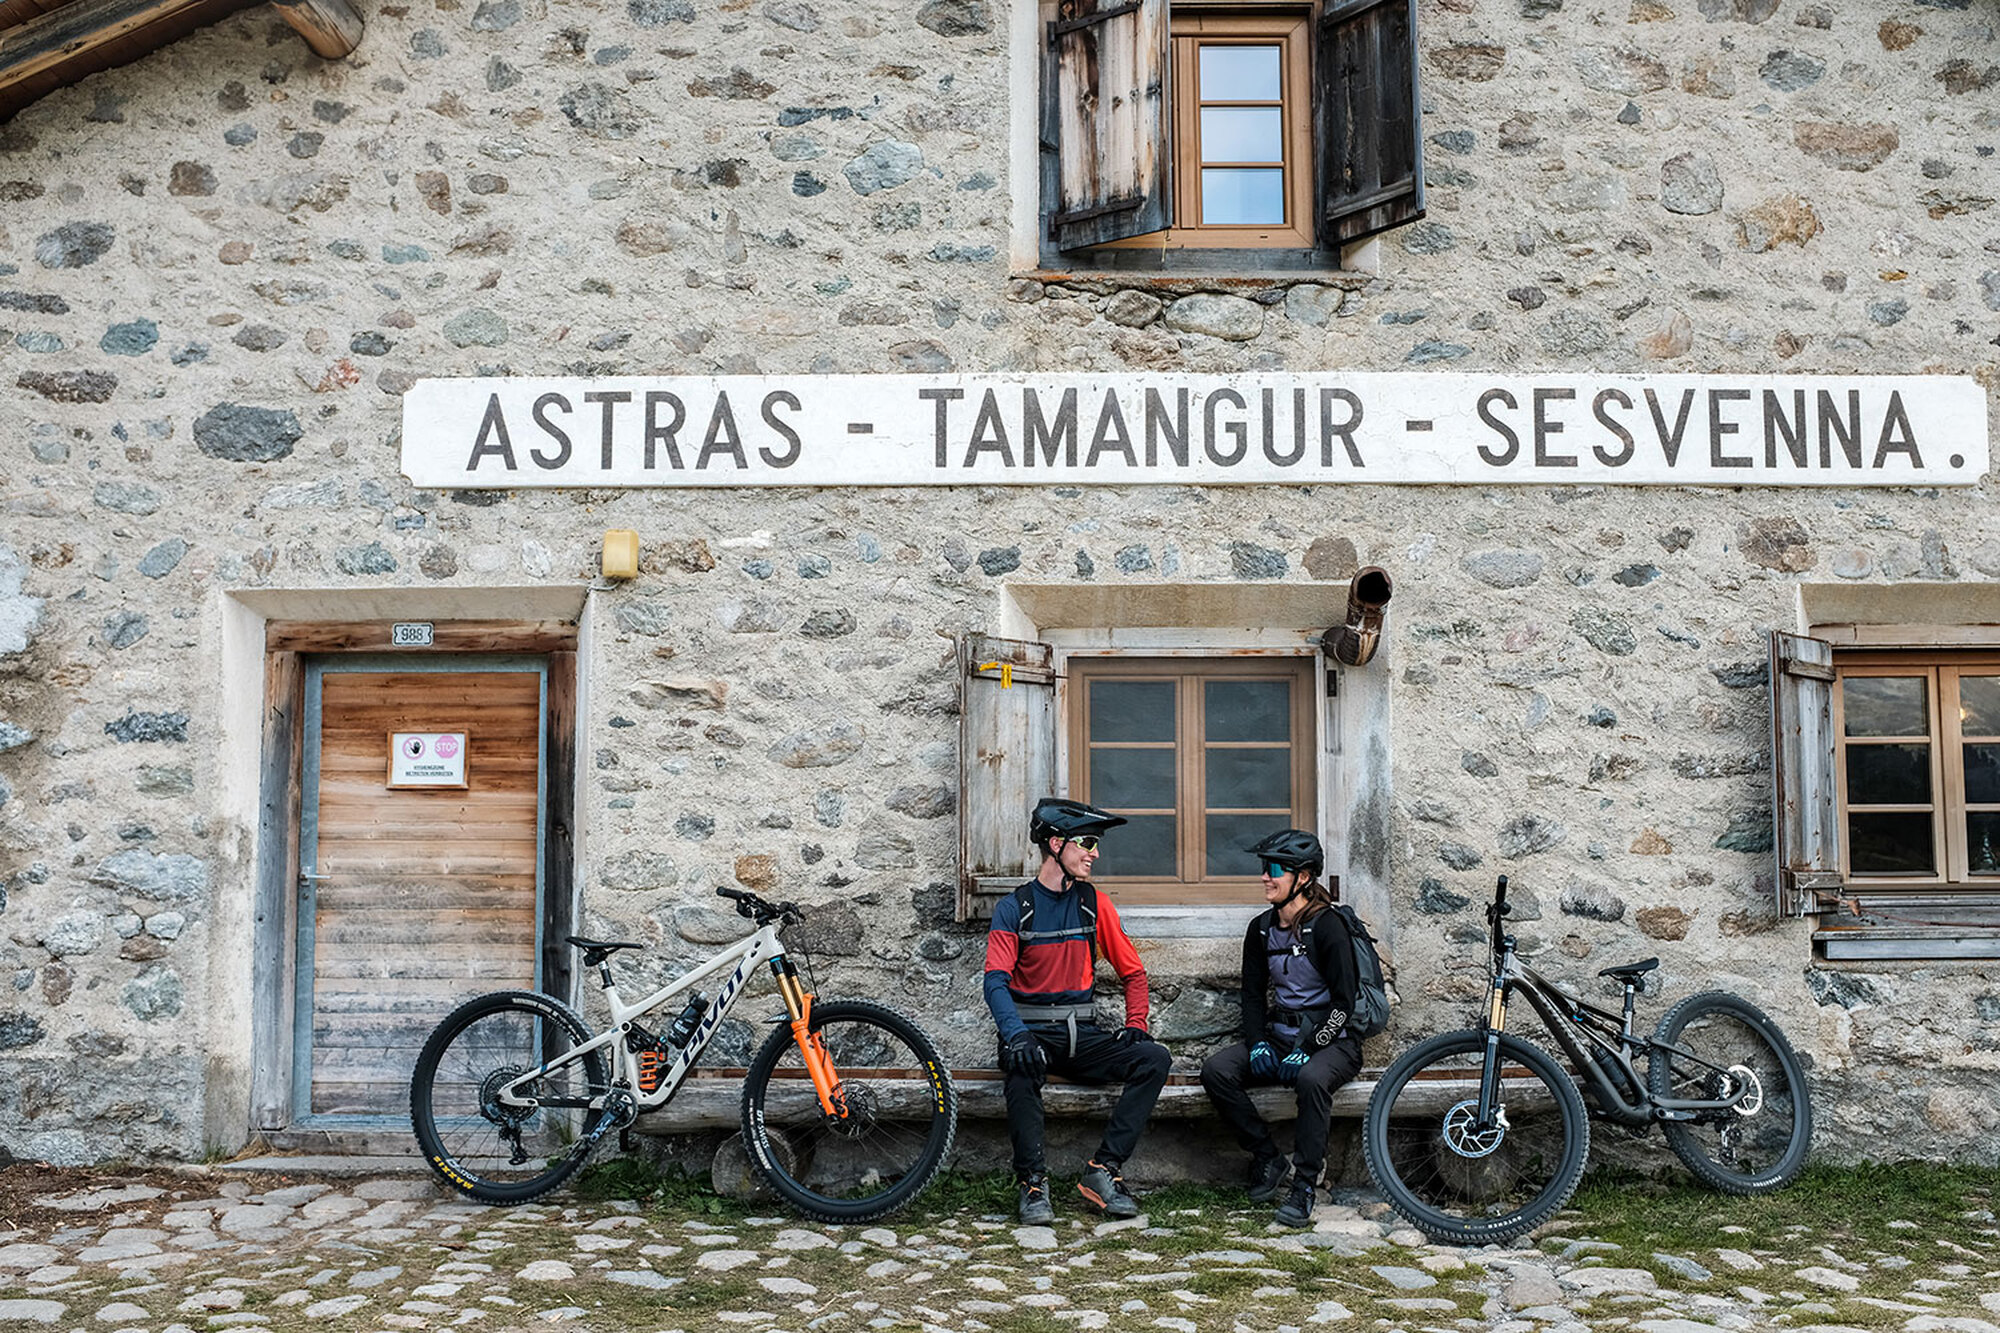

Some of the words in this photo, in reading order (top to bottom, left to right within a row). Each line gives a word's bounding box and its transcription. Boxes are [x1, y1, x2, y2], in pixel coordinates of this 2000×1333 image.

[466, 390, 802, 471] ASTRAS
[918, 387, 1366, 469] TAMANGUR
[401, 627, 423, 641] 988
[435, 742, 458, 753] STOP
[682, 956, 746, 1067] PIVOT
[927, 1060, 945, 1114] MAXXIS
[432, 1155, 475, 1190] MAXXIS
